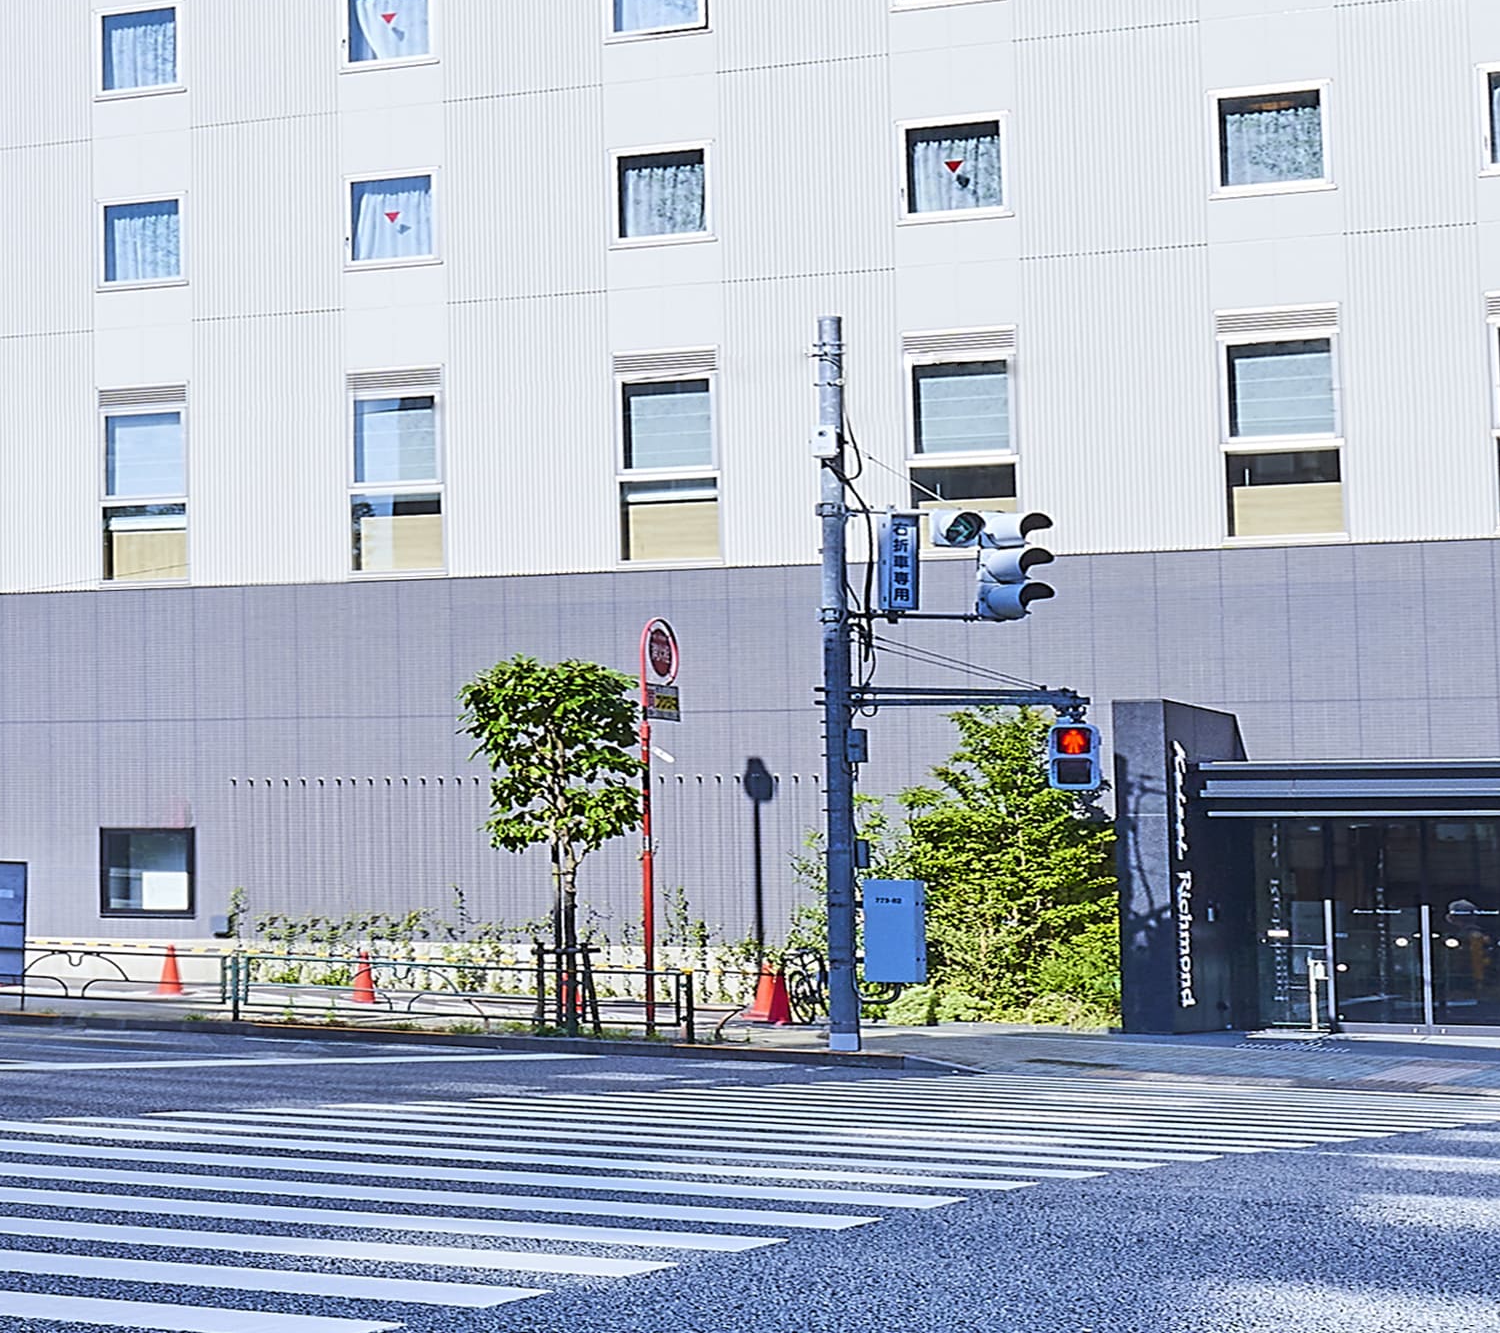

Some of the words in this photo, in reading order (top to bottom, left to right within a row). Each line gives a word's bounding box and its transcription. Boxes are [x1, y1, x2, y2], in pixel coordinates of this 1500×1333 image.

[893, 522, 909, 602] 右折車専用
[1176, 870, 1197, 1009] Richmond
